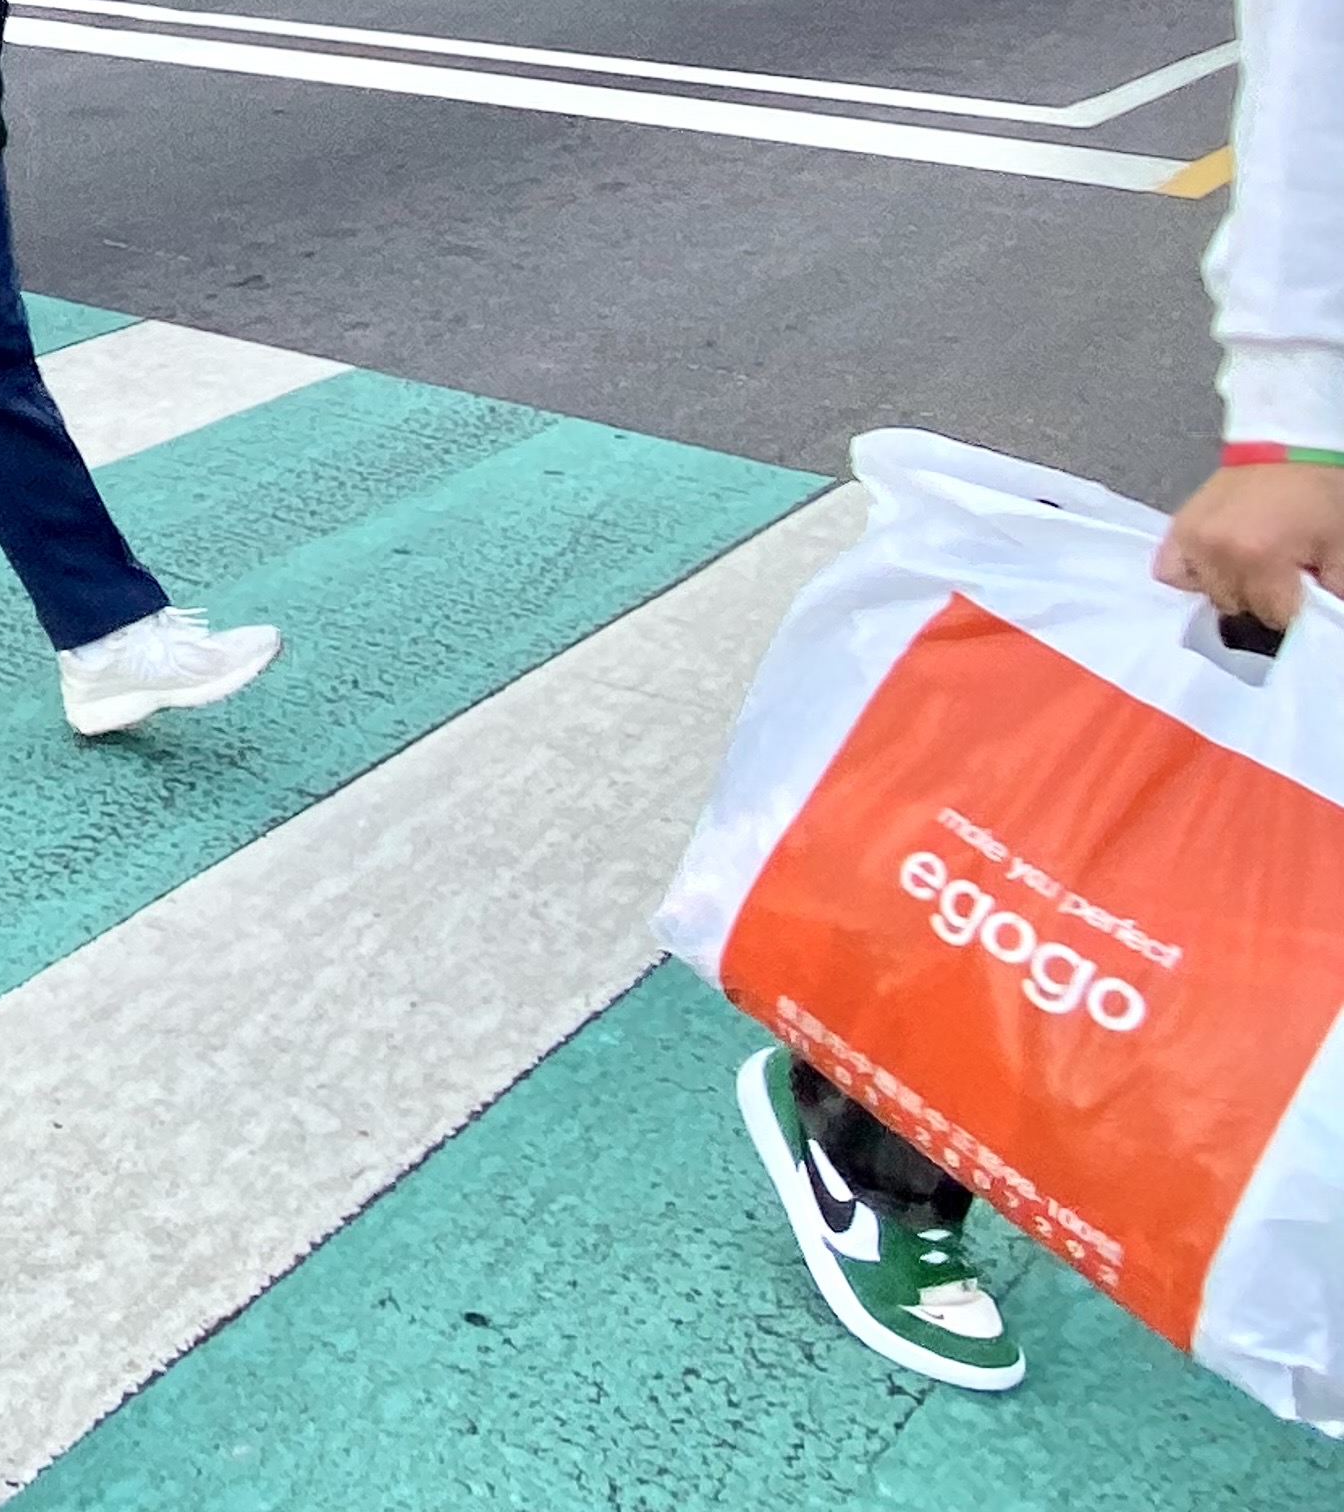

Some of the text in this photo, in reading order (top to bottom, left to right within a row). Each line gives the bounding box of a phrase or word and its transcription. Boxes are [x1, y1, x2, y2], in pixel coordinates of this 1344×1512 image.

[899, 850, 1148, 1032] egogo
[1005, 856, 1063, 899] you
[1057, 890, 1183, 969] perfect
